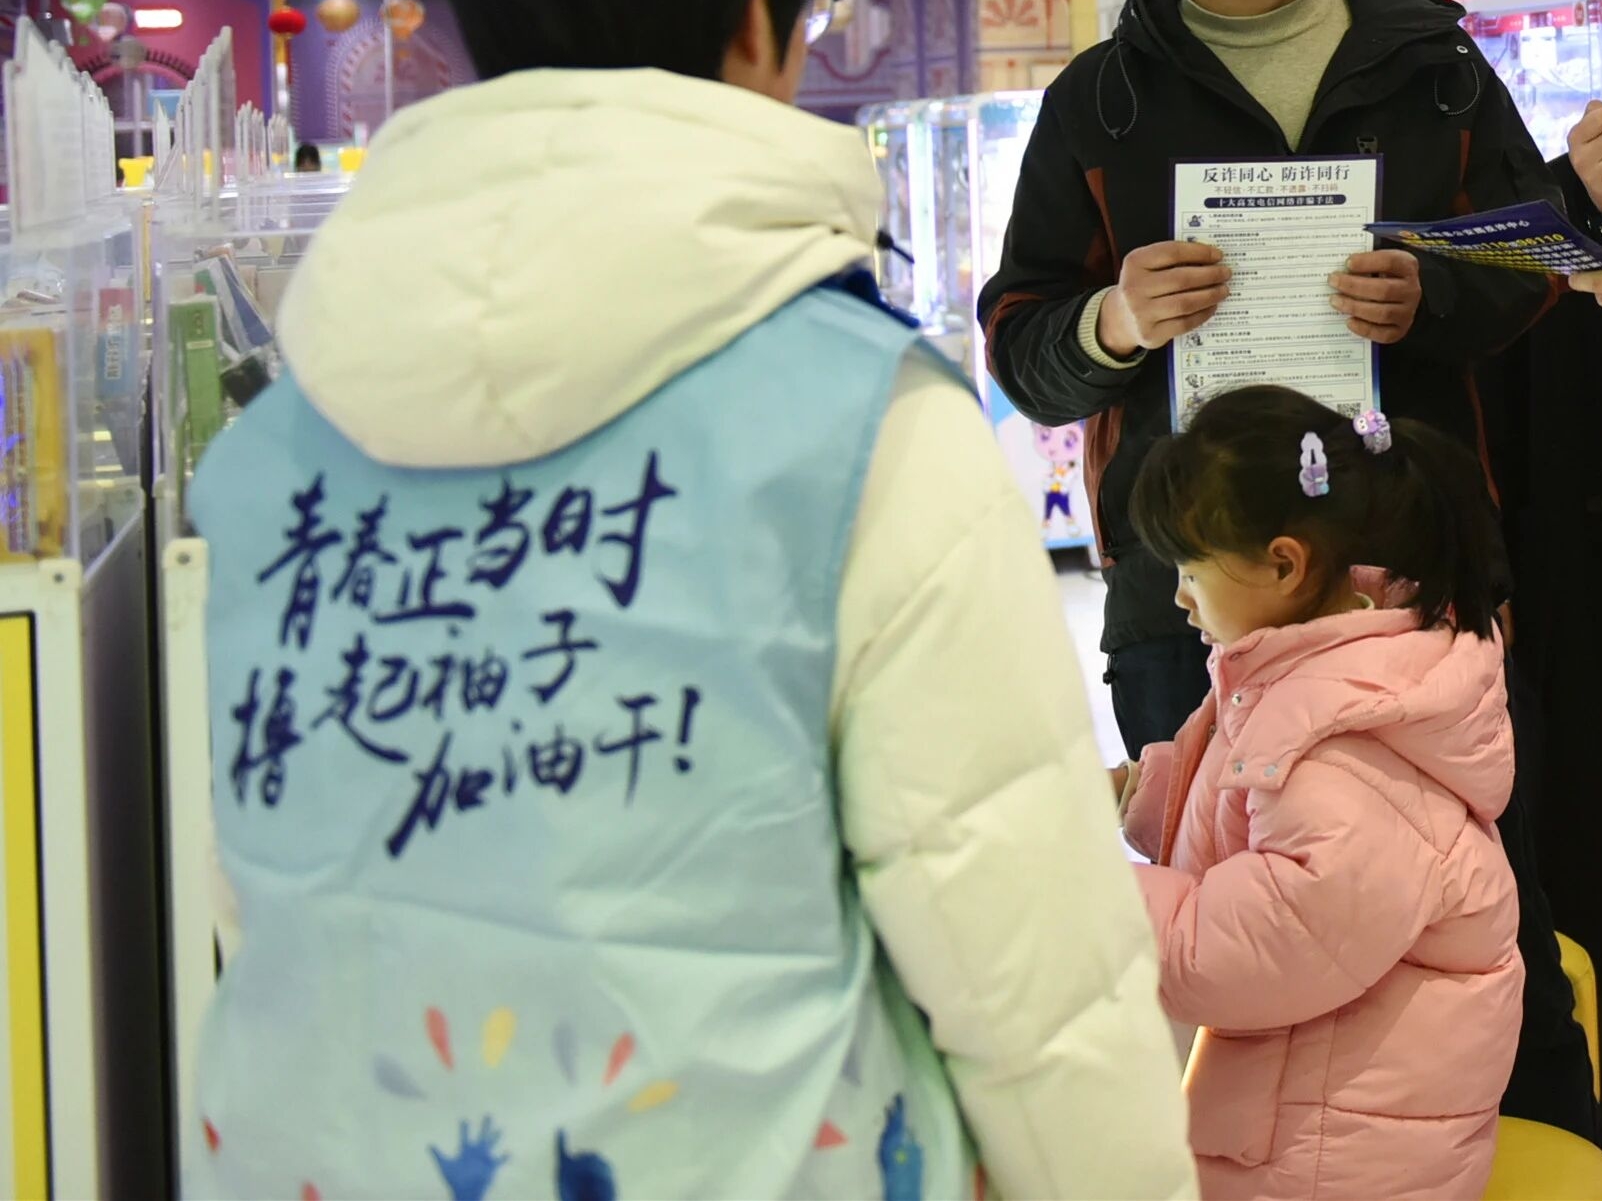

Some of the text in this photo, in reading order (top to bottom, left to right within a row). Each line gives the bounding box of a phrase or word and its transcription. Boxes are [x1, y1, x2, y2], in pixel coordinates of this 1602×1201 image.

[1203, 165, 1350, 183] 反诈同心 防诈同行
[257, 449, 679, 651] 青春正当时
[231, 609, 599, 809] 撸起袖子
